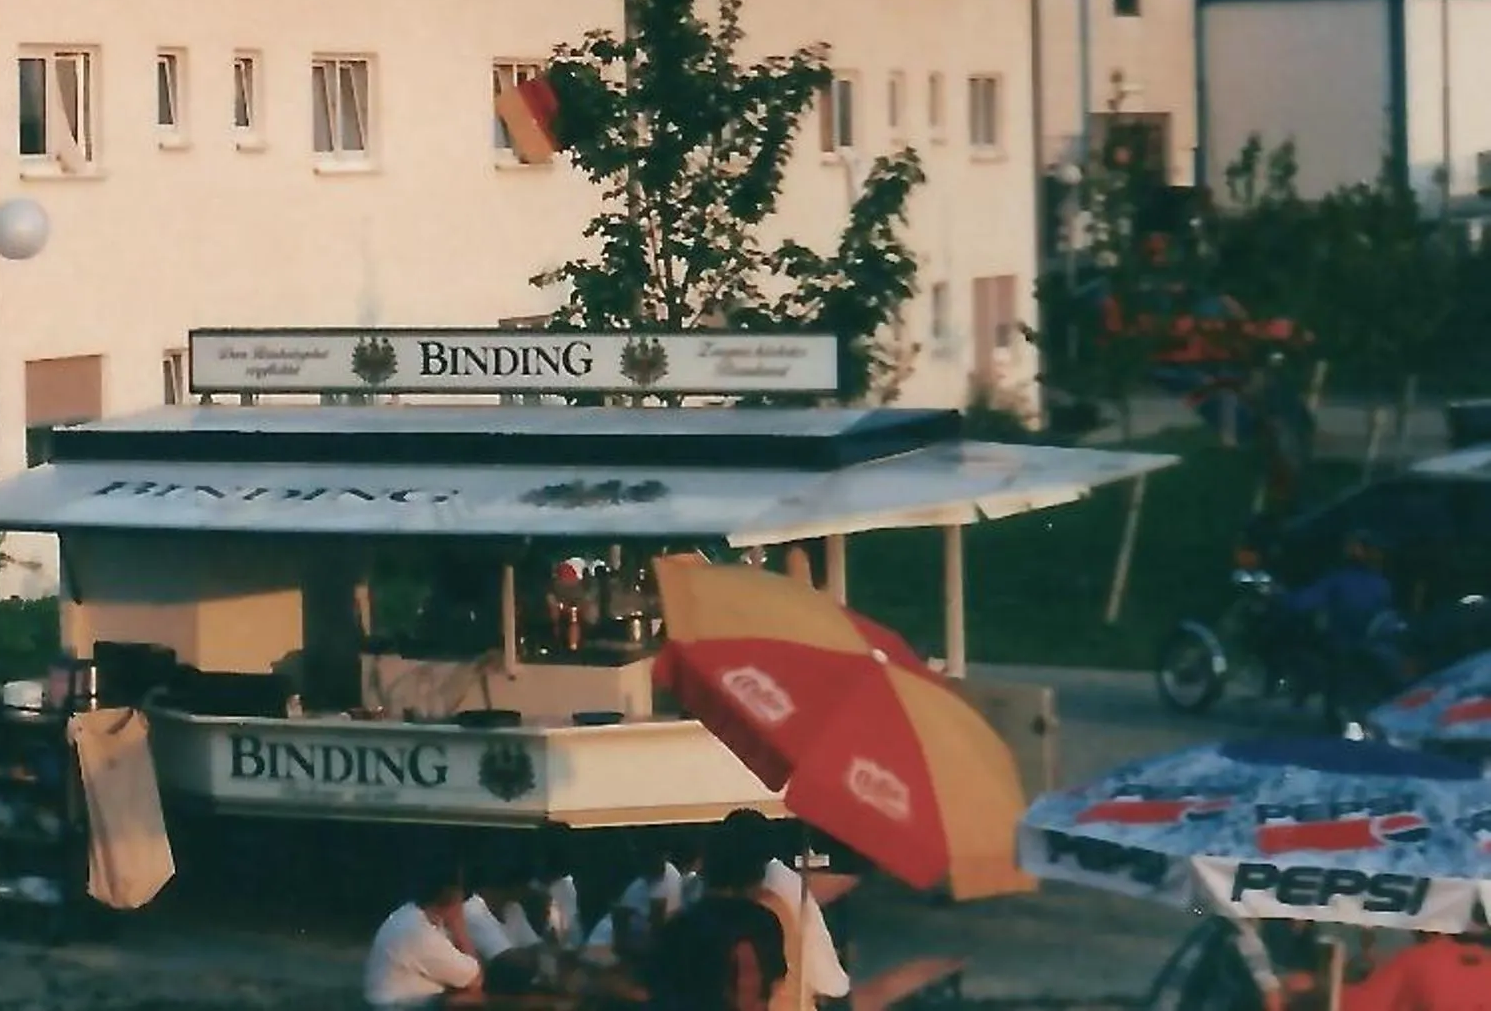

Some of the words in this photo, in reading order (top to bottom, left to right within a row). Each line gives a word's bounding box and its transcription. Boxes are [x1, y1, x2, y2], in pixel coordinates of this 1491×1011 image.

[418, 339, 594, 378] BINDING
[229, 732, 450, 789] BINDING
[1230, 862, 1431, 916] PEPSI
